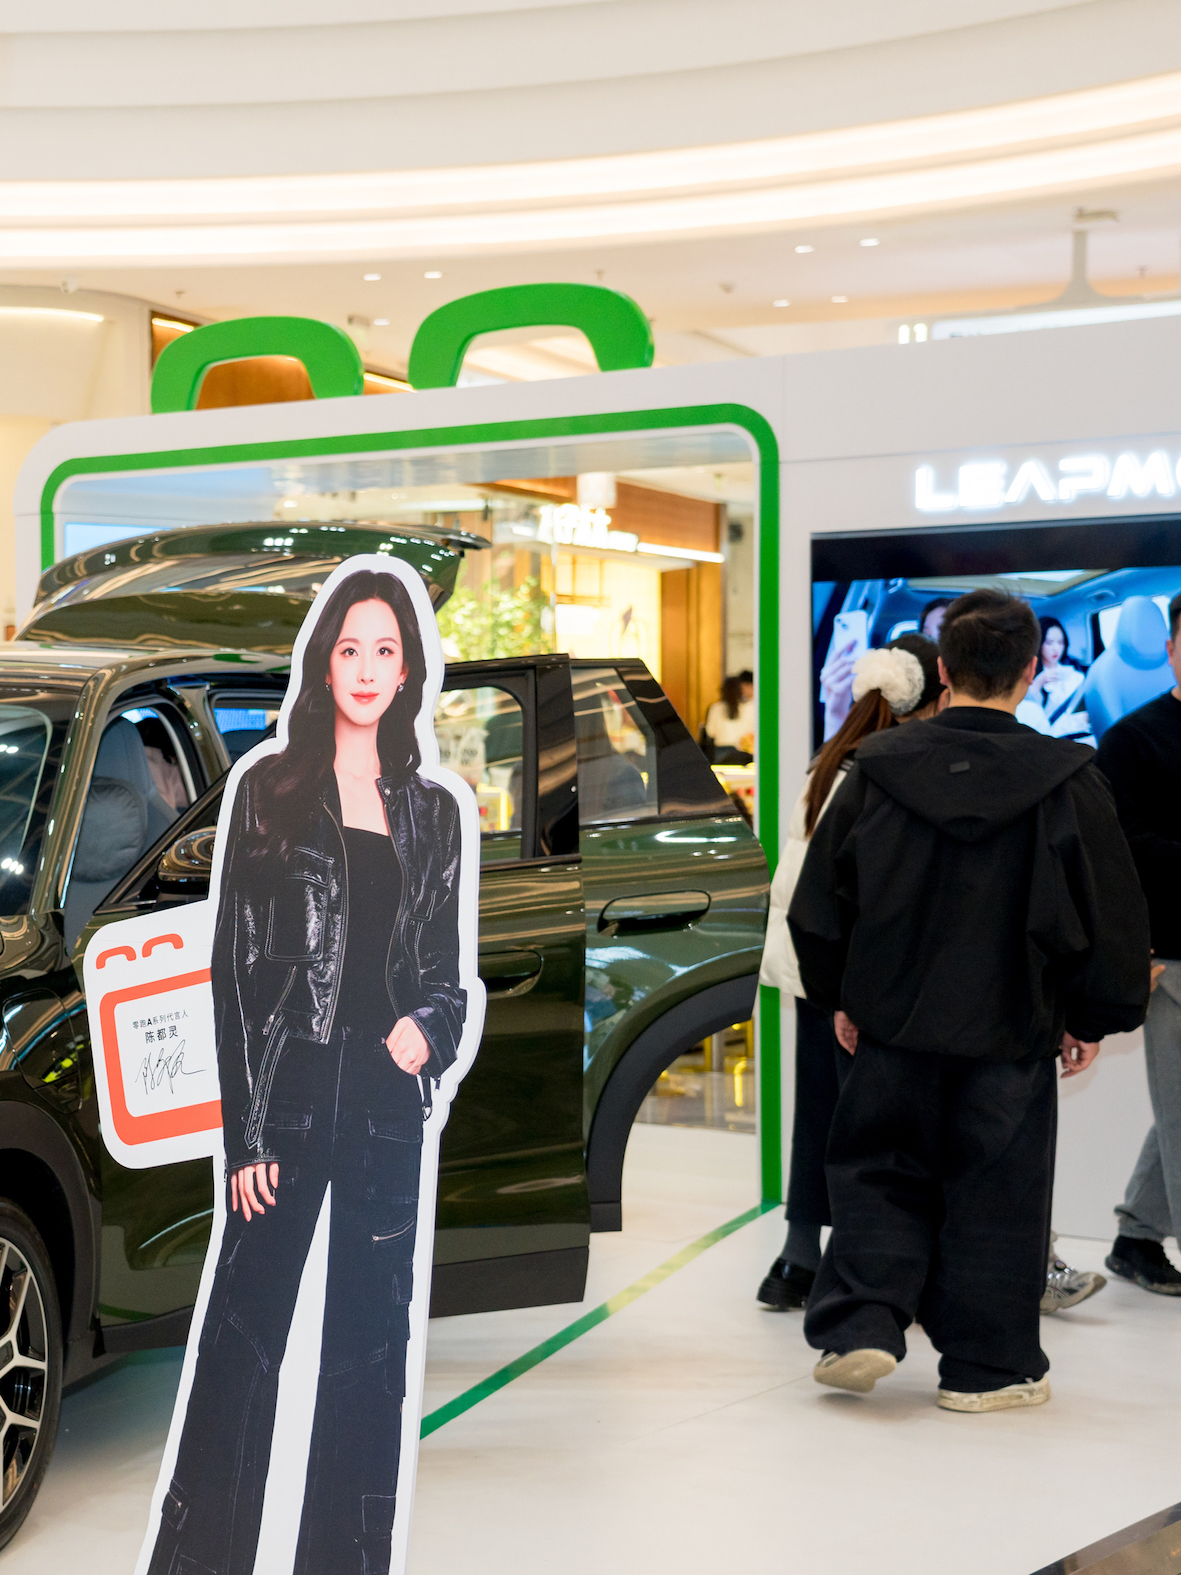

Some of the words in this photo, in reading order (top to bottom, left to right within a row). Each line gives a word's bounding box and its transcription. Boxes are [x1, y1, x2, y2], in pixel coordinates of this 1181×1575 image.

[915, 450, 1181, 511] LEAPM
[144, 1025, 179, 1044] 陈都灵
